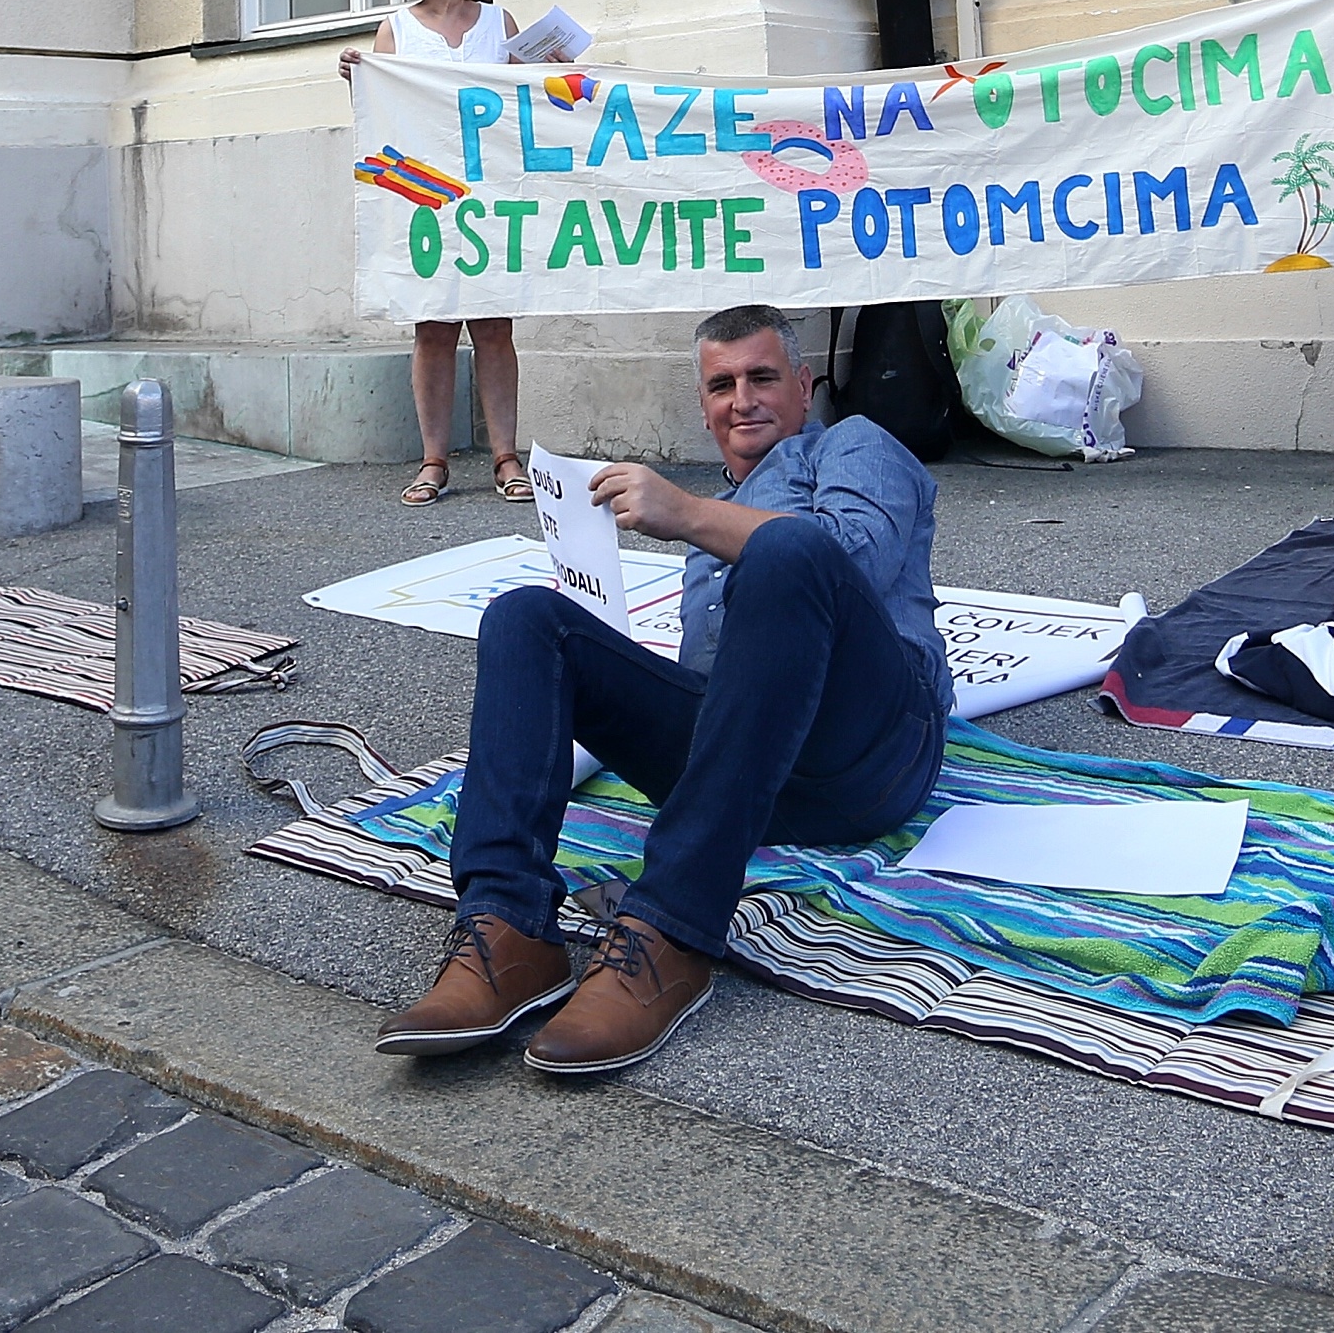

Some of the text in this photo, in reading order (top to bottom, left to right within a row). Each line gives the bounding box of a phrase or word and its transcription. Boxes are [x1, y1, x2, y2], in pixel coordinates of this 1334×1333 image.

[823, 82, 934, 141] NA
[973, 29, 1331, 130] OTOCIMA
[409, 164, 1259, 279] OSTAVITE POTOMCIMA
[542, 511, 560, 542] STE
[948, 611, 1111, 641] ČOVJEK
[948, 667, 1010, 684] KA
